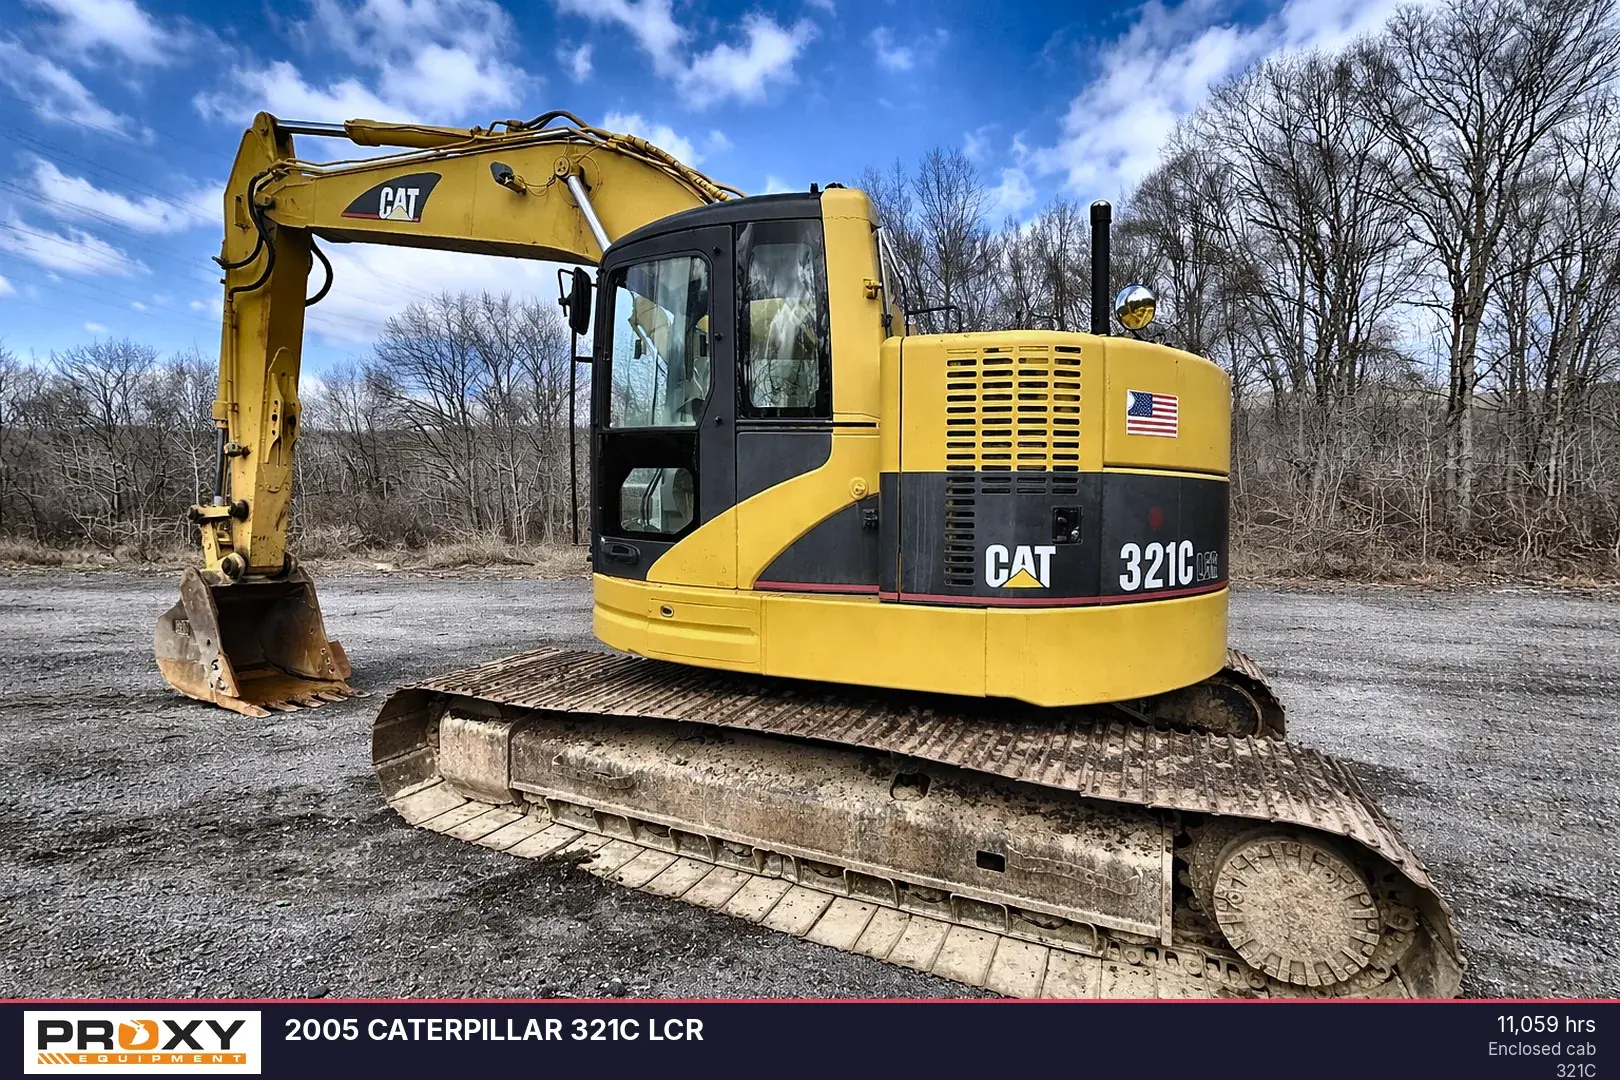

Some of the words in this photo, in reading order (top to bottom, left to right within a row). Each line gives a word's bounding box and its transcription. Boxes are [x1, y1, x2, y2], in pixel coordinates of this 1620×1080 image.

[379, 187, 420, 220] CAT
[985, 544, 1056, 588] CAT
[1119, 540, 1193, 591] 321C
